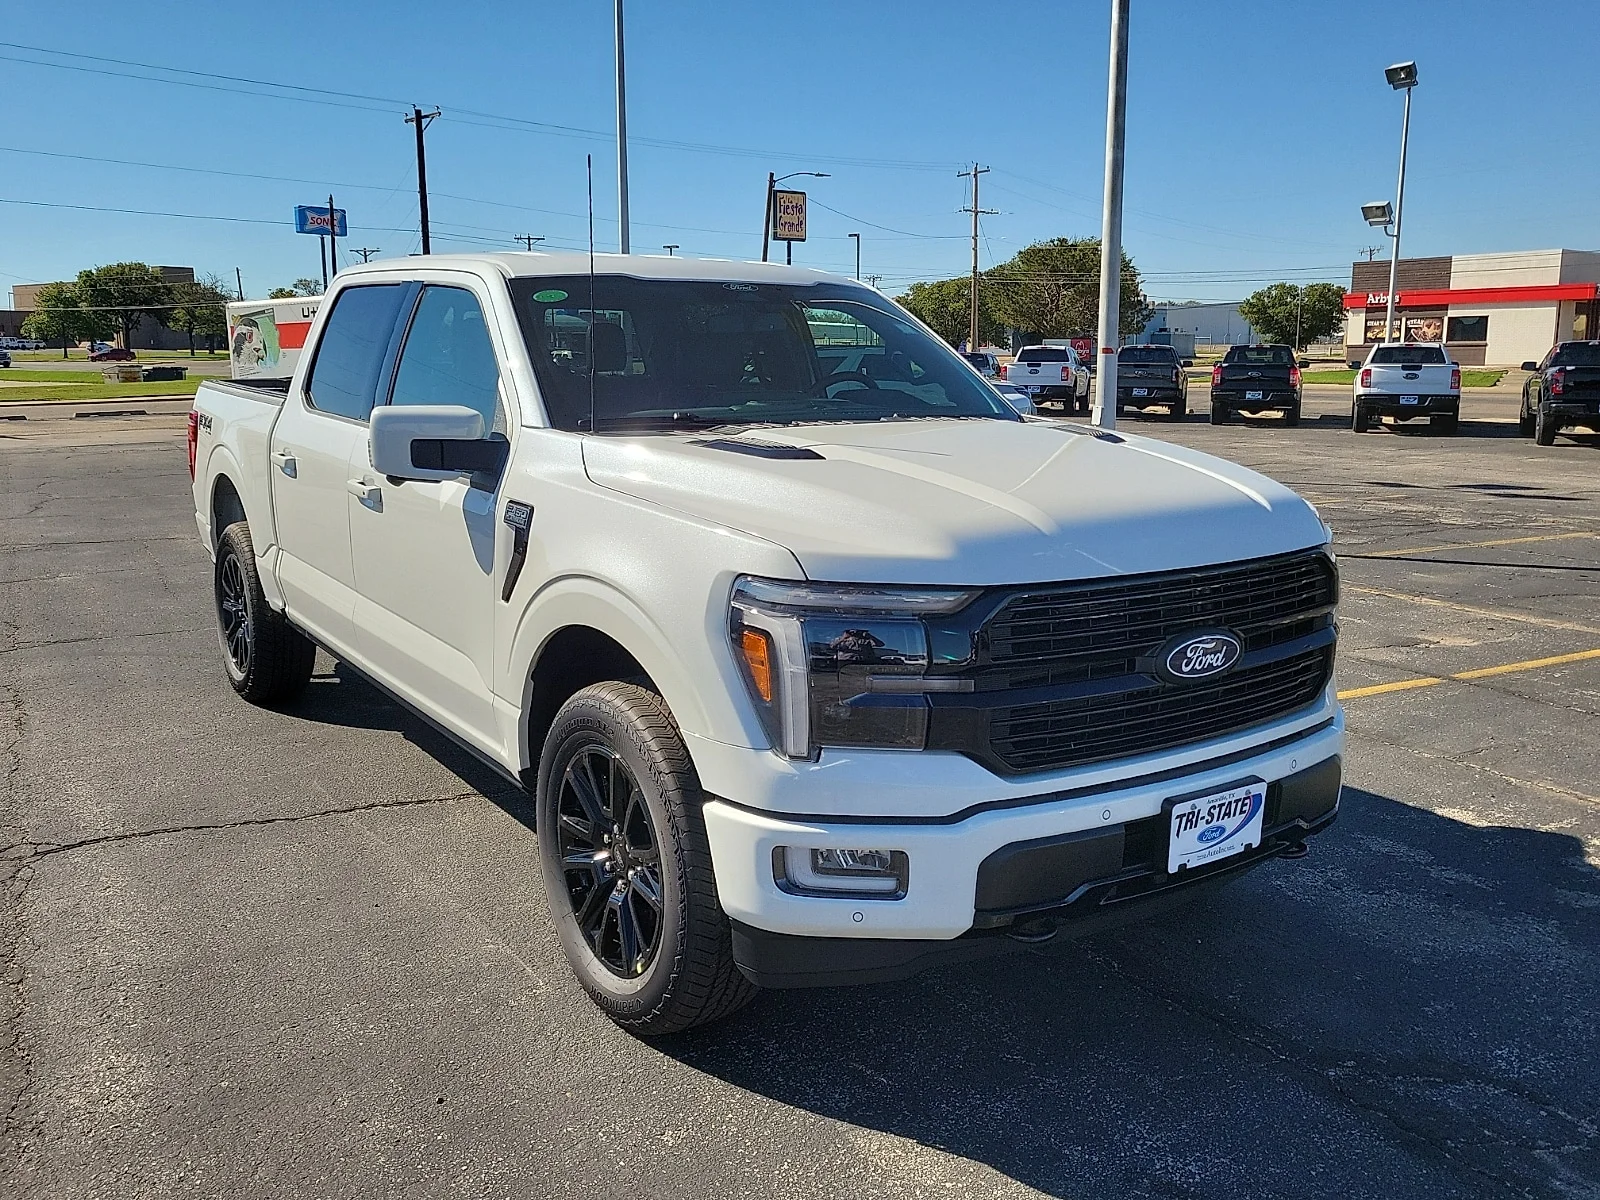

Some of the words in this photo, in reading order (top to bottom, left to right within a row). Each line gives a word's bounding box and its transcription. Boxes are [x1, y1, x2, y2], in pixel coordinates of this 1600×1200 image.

[779, 196, 804, 216] Fiesta
[310, 216, 336, 227] SON
[779, 215, 804, 233] Grande
[1367, 293, 1400, 306] Arbs
[1182, 642, 1227, 673] Ford
[1175, 796, 1252, 839] TRI-STATE
